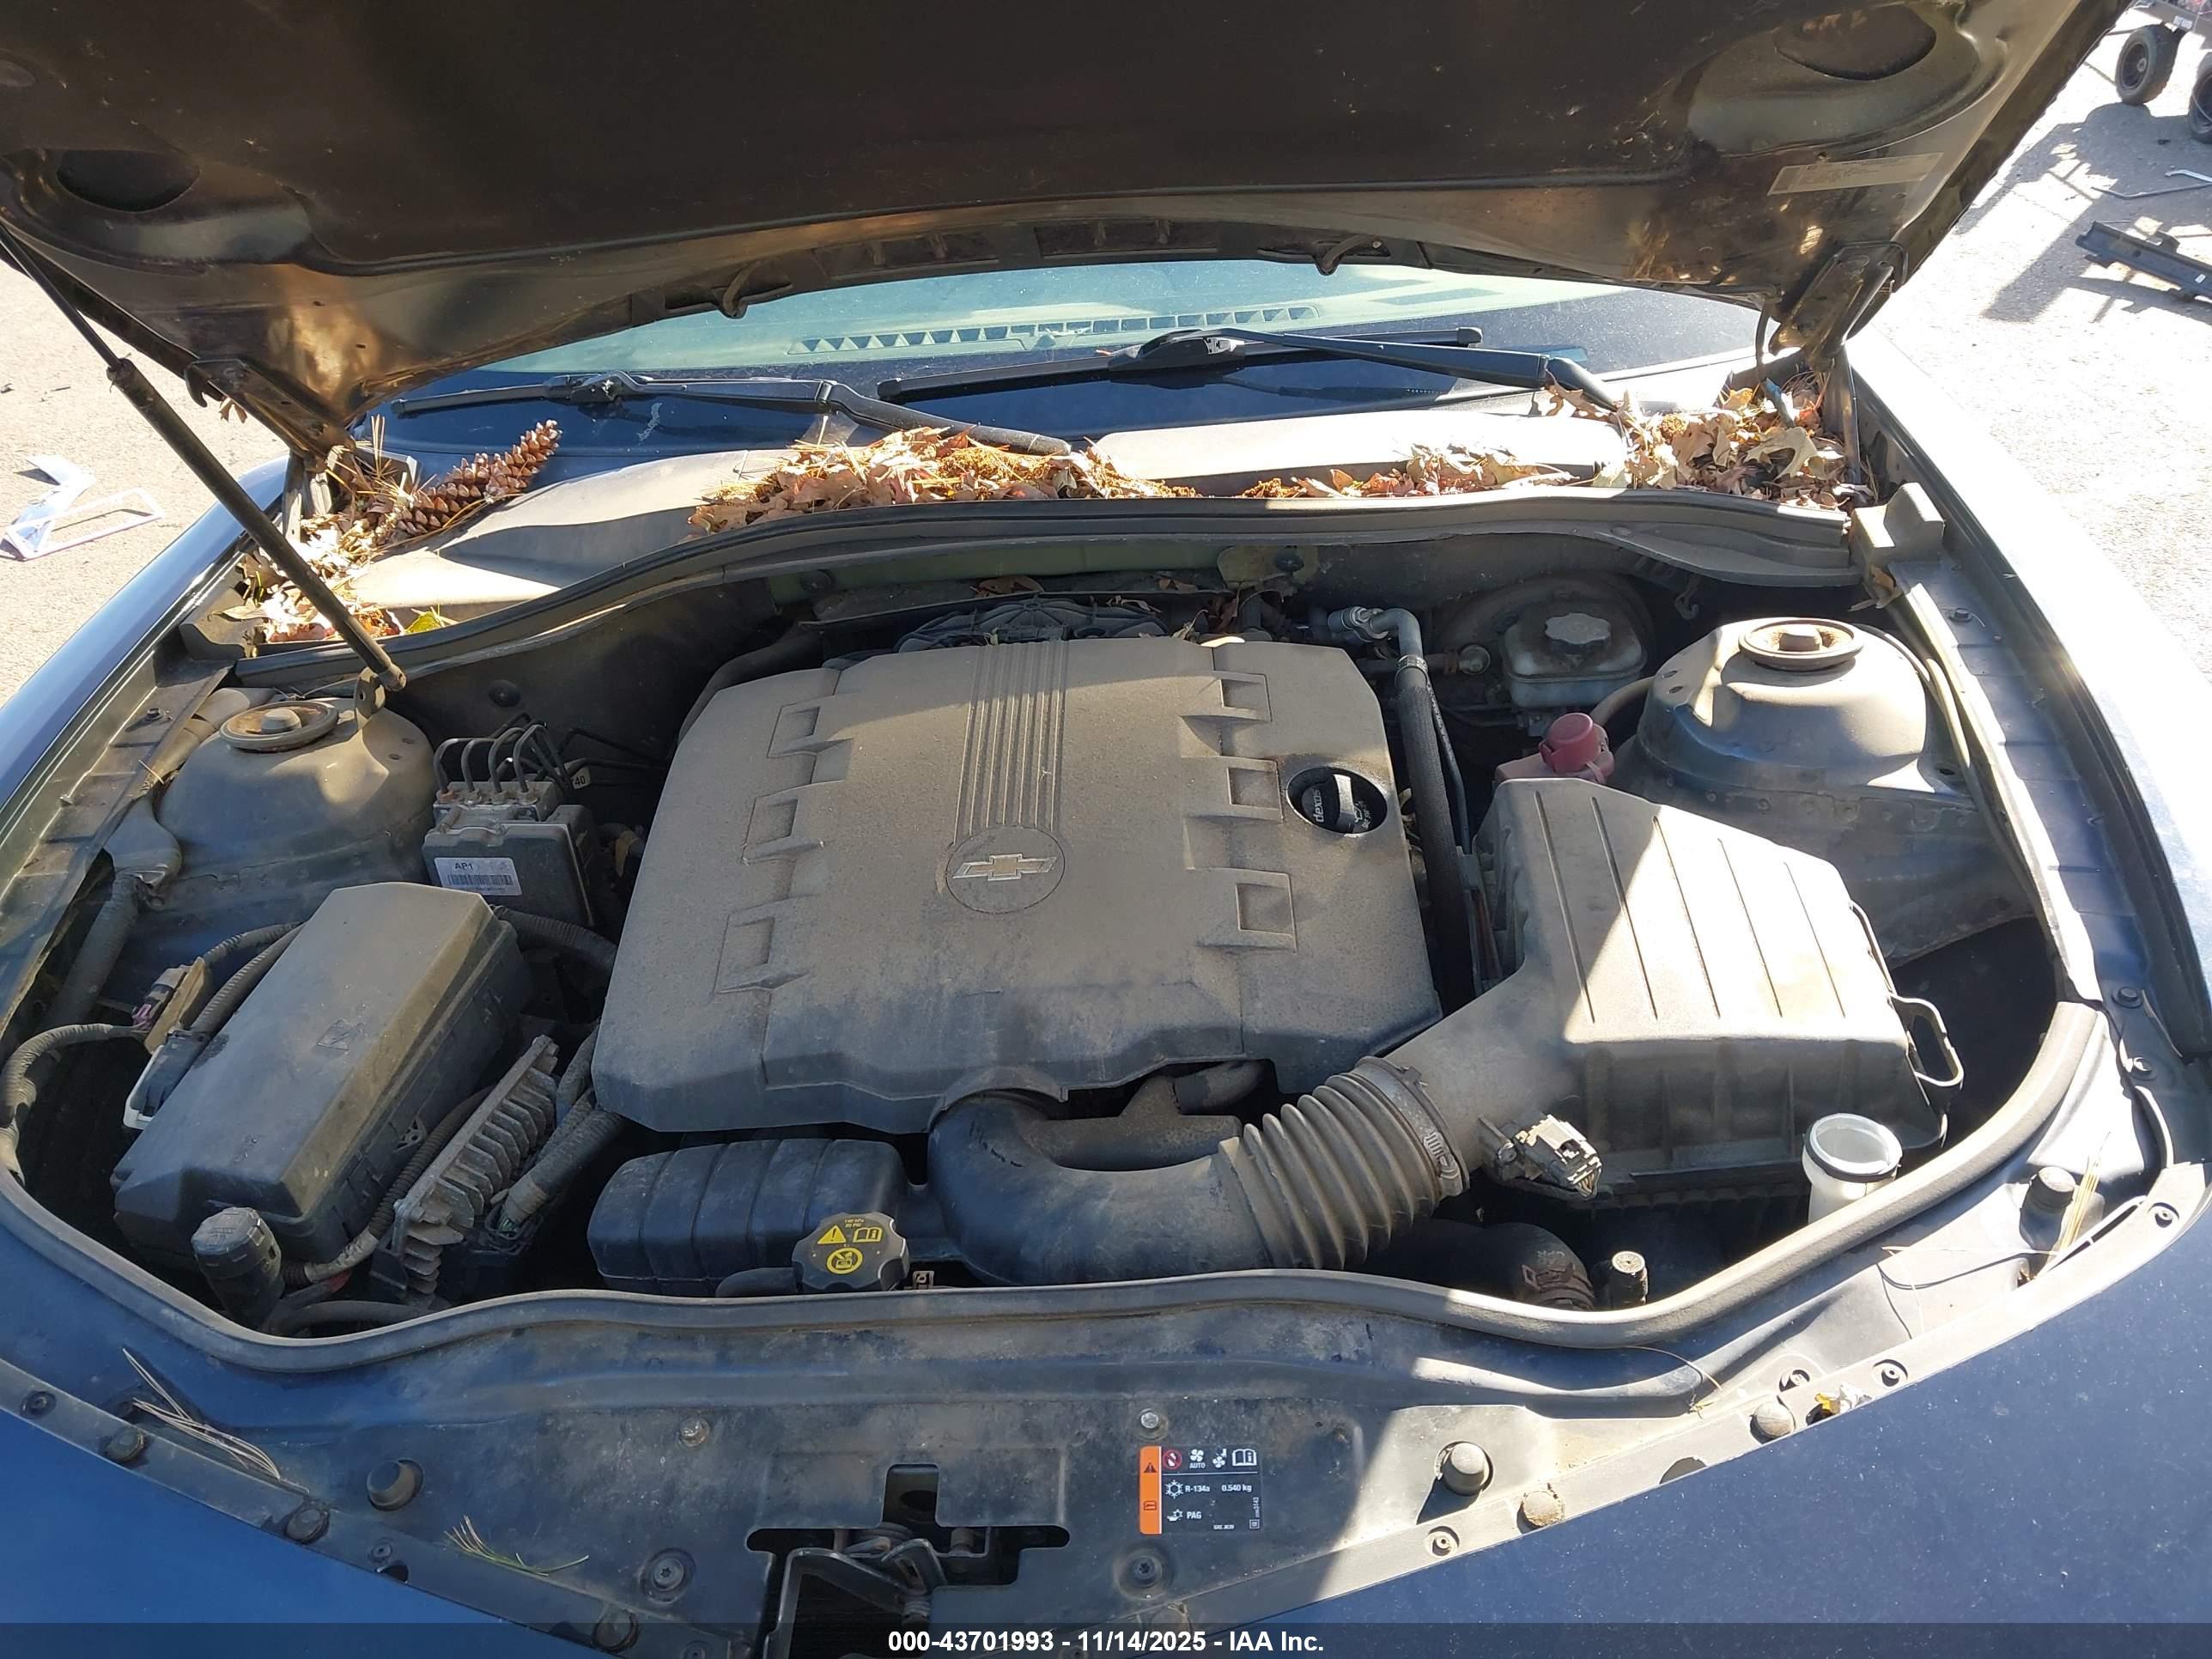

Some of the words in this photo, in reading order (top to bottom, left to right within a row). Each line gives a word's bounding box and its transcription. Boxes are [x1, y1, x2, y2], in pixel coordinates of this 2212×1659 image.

[1312, 789, 1324, 823] dexos
[1243, 1484, 1252, 1492] kg
[1187, 1510, 1202, 1520] PAG
